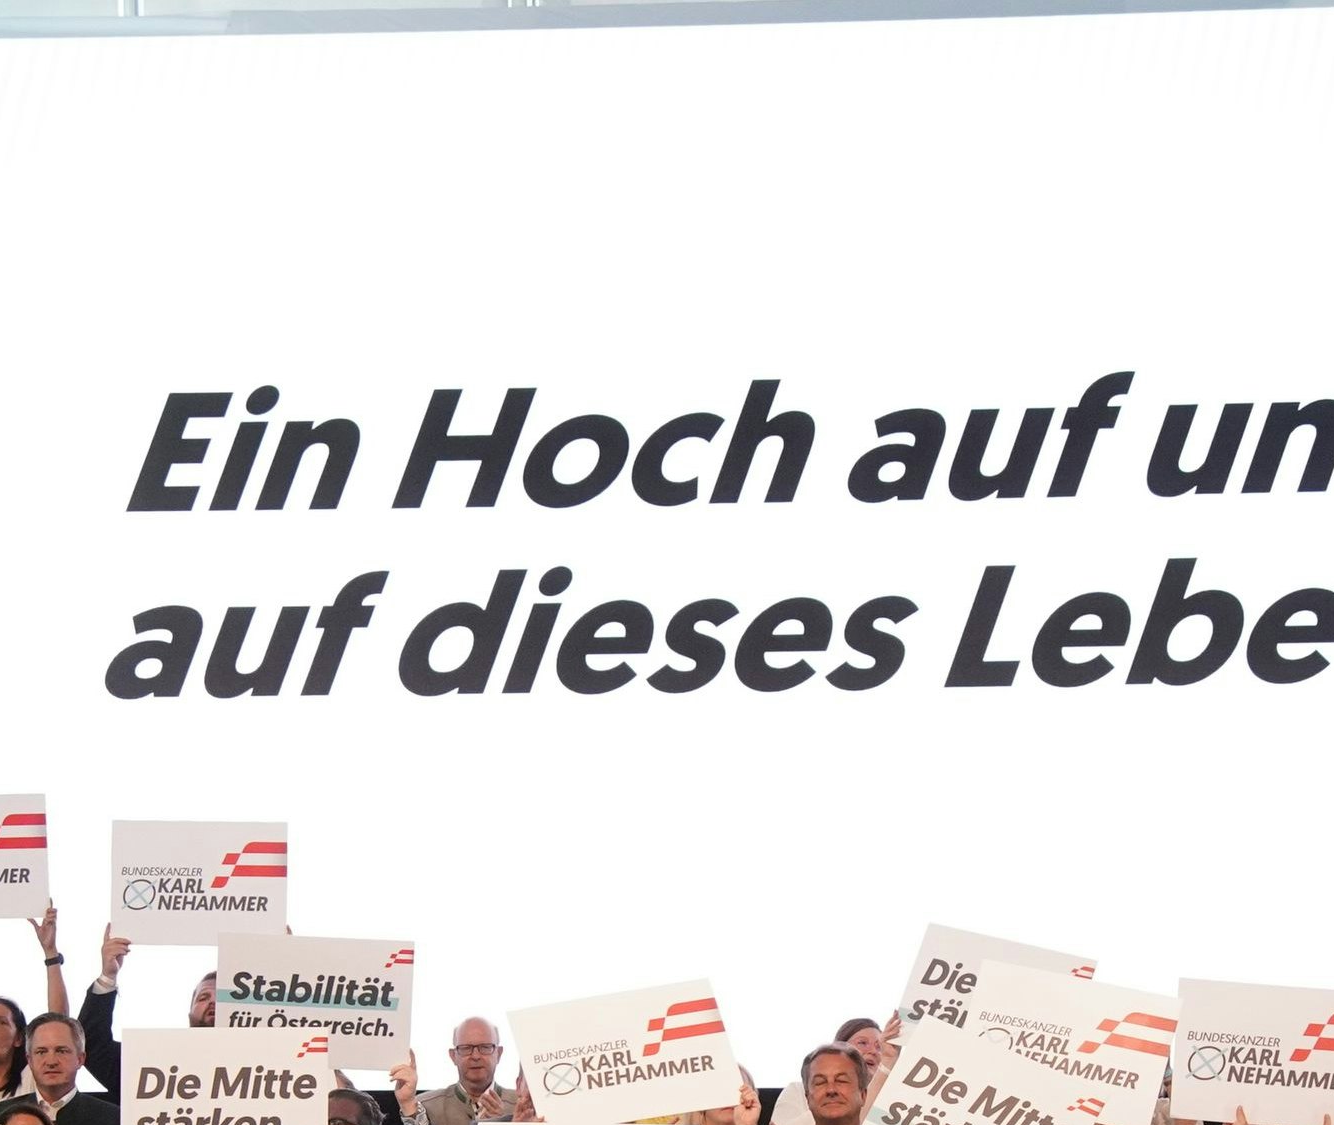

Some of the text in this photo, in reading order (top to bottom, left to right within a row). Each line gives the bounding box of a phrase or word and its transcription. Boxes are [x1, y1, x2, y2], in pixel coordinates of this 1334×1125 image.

[125, 384, 361, 512] Ein
[391, 379, 816, 509] Hoch
[847, 370, 1136, 504] auf
[104, 570, 390, 700] auf
[398, 565, 919, 697] dieses
[122, 866, 203, 878] BUNDESKANZLER
[157, 877, 205, 894] KARL
[158, 894, 269, 912] NEHAMMER
[229, 971, 395, 1008] Stabilität
[920, 958, 977, 994] Die
[228, 1009, 395, 1038] für Österreich.
[978, 1010, 1073, 1037] BUNDESKANZLER
[533, 1039, 629, 1064] BUNDESKANZLER
[1015, 1030, 1070, 1056] KARL
[1187, 1030, 1281, 1047] BUNDESKANZLER
[581, 1049, 637, 1073] KARL
[1227, 1046, 1283, 1067] KARL
[136, 1065, 317, 1100] Die Mitte
[586, 1055, 715, 1090] NEHAMMER
[902, 1056, 968, 1105] Die
